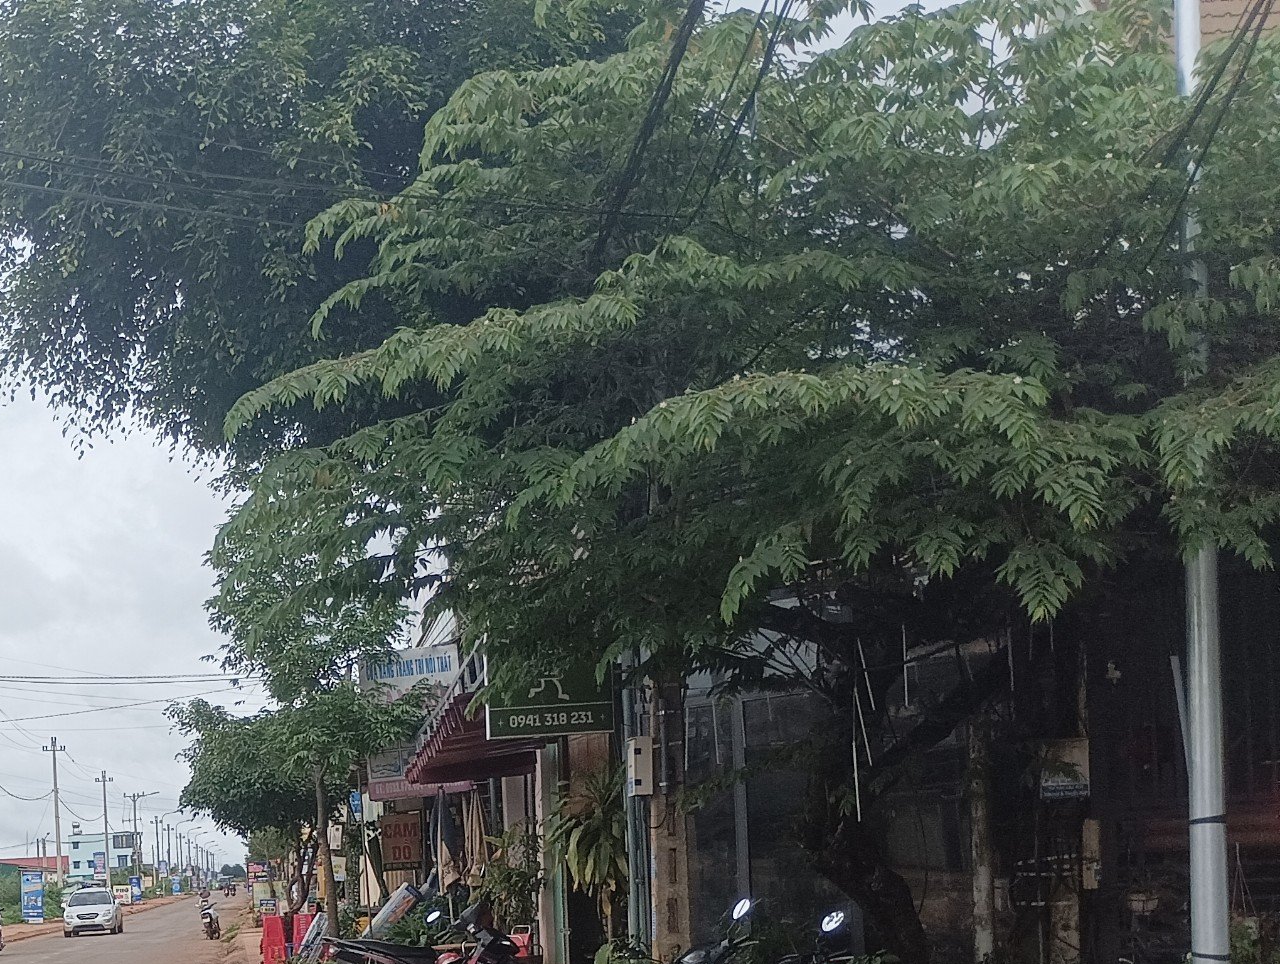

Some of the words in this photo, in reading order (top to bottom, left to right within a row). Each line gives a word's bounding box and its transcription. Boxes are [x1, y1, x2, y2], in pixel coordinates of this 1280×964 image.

[509, 713, 541, 728] 0941
[544, 712, 567, 726] 318
[570, 711, 594, 724] 231
